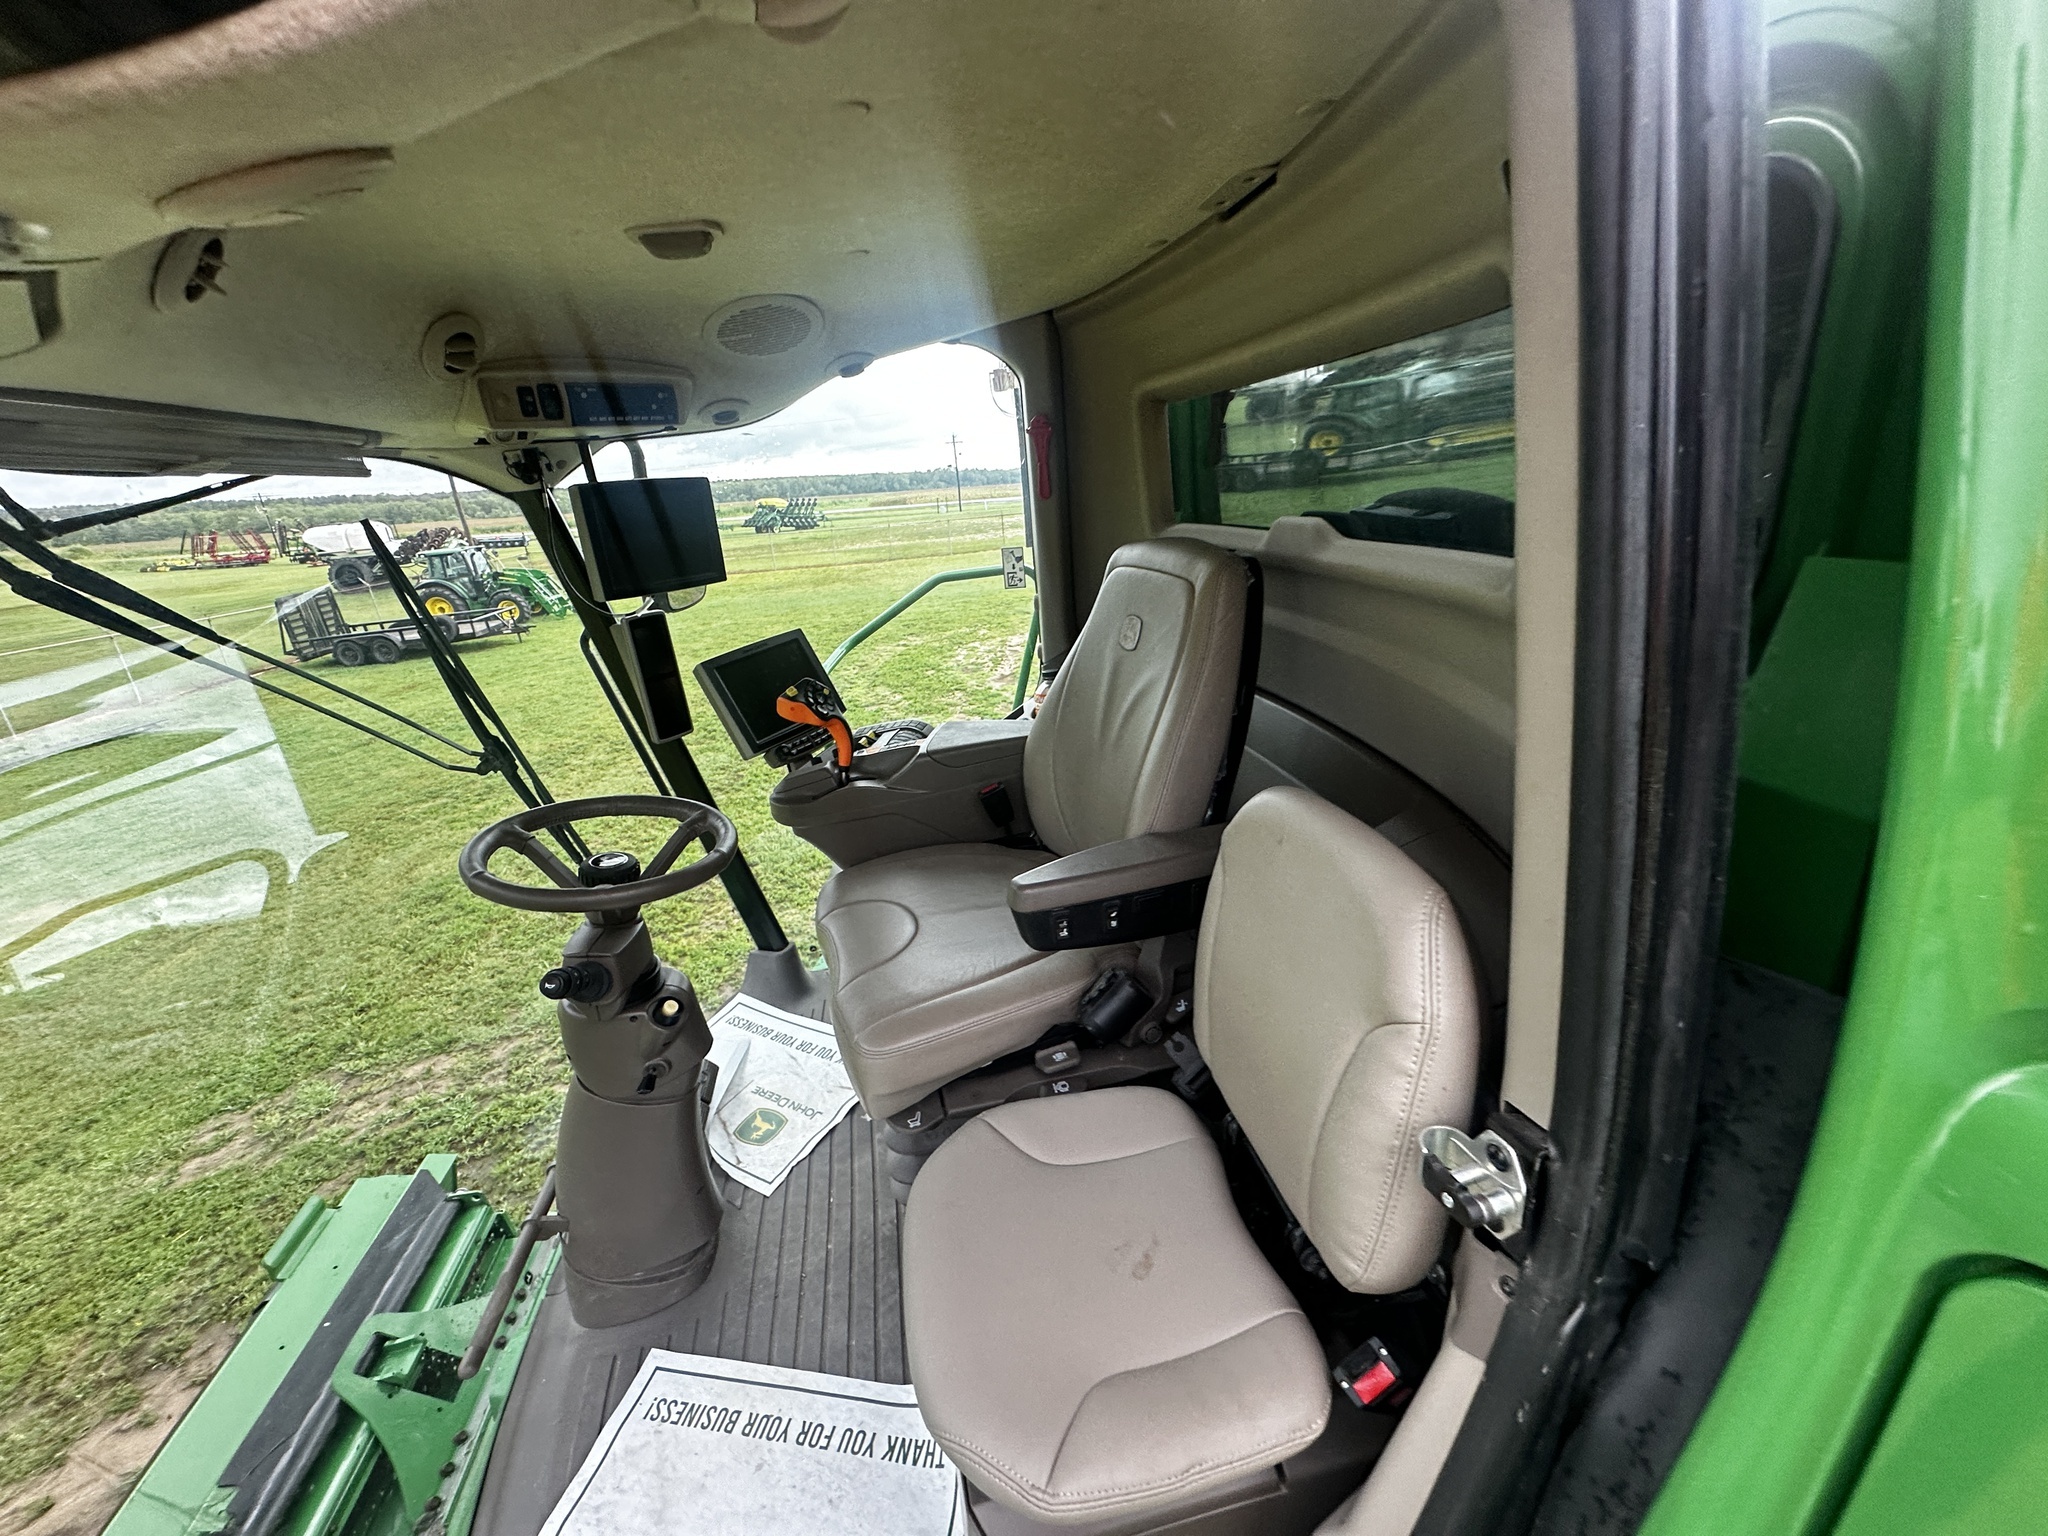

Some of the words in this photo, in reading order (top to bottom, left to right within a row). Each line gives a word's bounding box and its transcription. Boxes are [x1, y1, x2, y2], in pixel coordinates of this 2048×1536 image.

[725, 1015, 774, 1038] BUSINESS!
[771, 1031, 798, 1047] YOUR
[796, 1040, 818, 1054] FOR
[815, 1046, 837, 1061] YOU
[751, 1085, 790, 1108] DEERE
[788, 1100, 823, 1120] JOHN
[642, 1397, 742, 1434] BUSINESS!
[741, 1412, 792, 1443] YOUR
[795, 1420, 836, 1450] FOR
[837, 1428, 877, 1458] YOU
[881, 1435, 945, 1468] THANK
